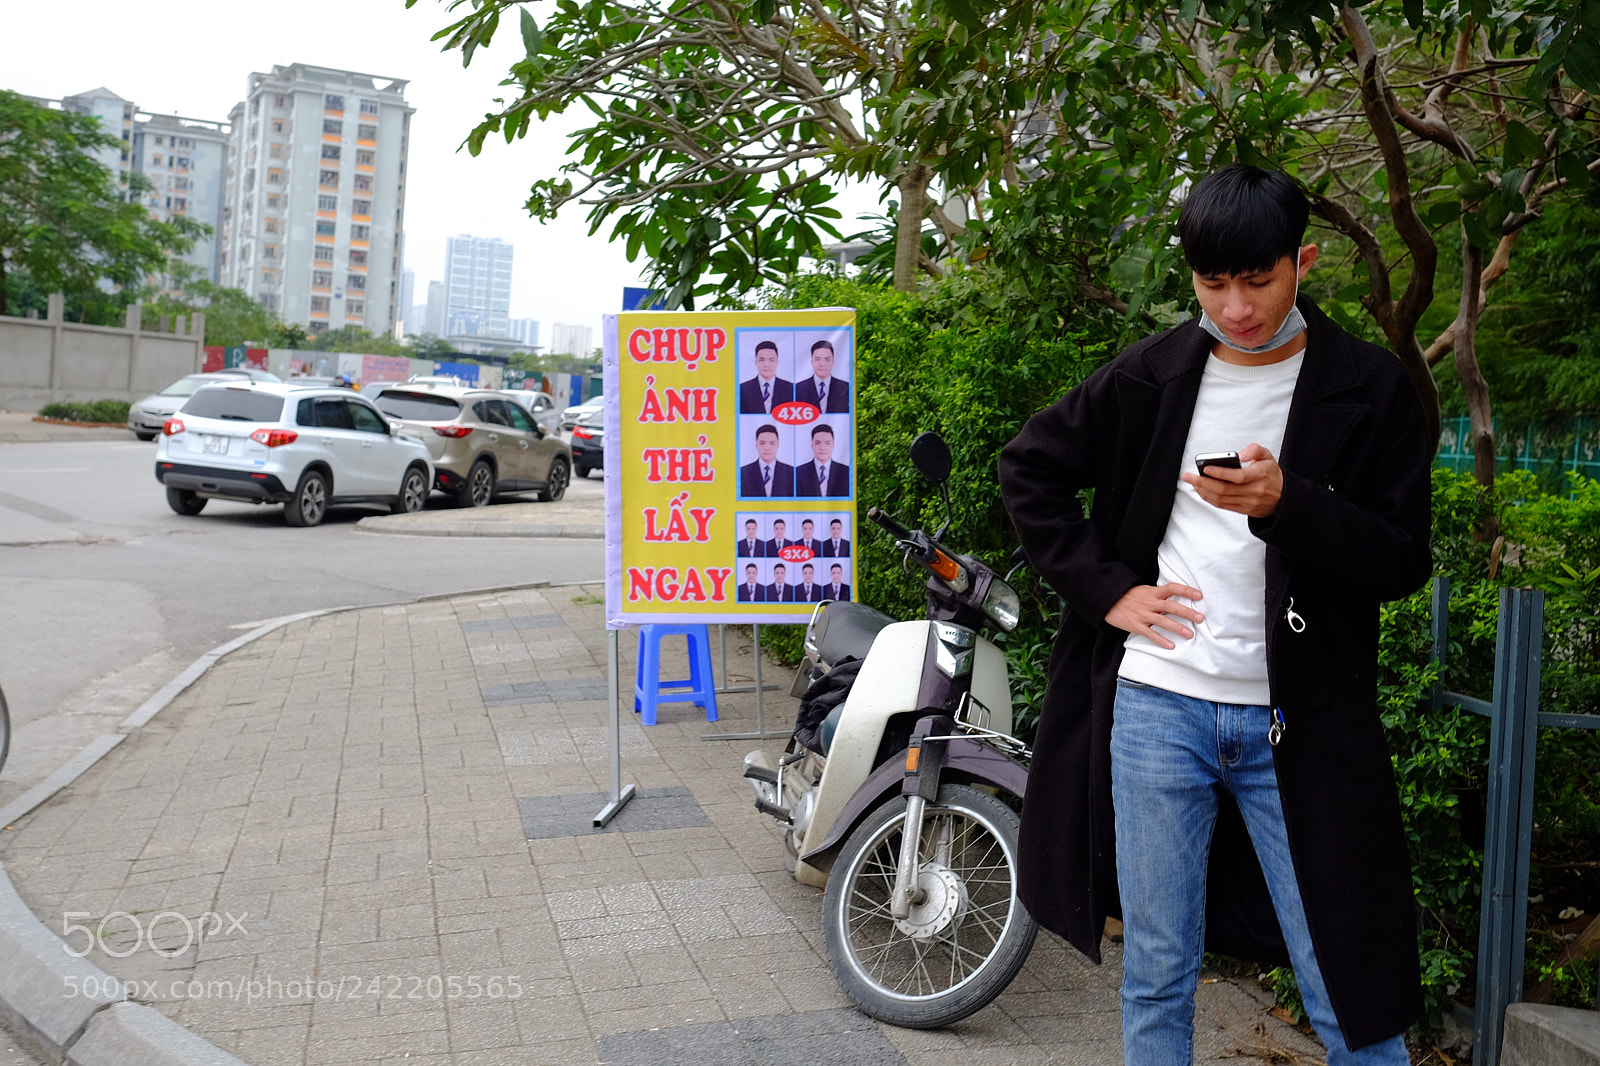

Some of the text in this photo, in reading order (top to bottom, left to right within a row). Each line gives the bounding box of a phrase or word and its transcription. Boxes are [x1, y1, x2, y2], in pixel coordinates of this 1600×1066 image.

[628, 327, 726, 370] CHỤP
[638, 375, 718, 423] ẢNH
[778, 407, 814, 420] 4X6
[642, 434, 714, 483] THẺ
[643, 492, 716, 543] LẤY
[783, 549, 810, 560] 3X4
[627, 567, 732, 603] NGAY
